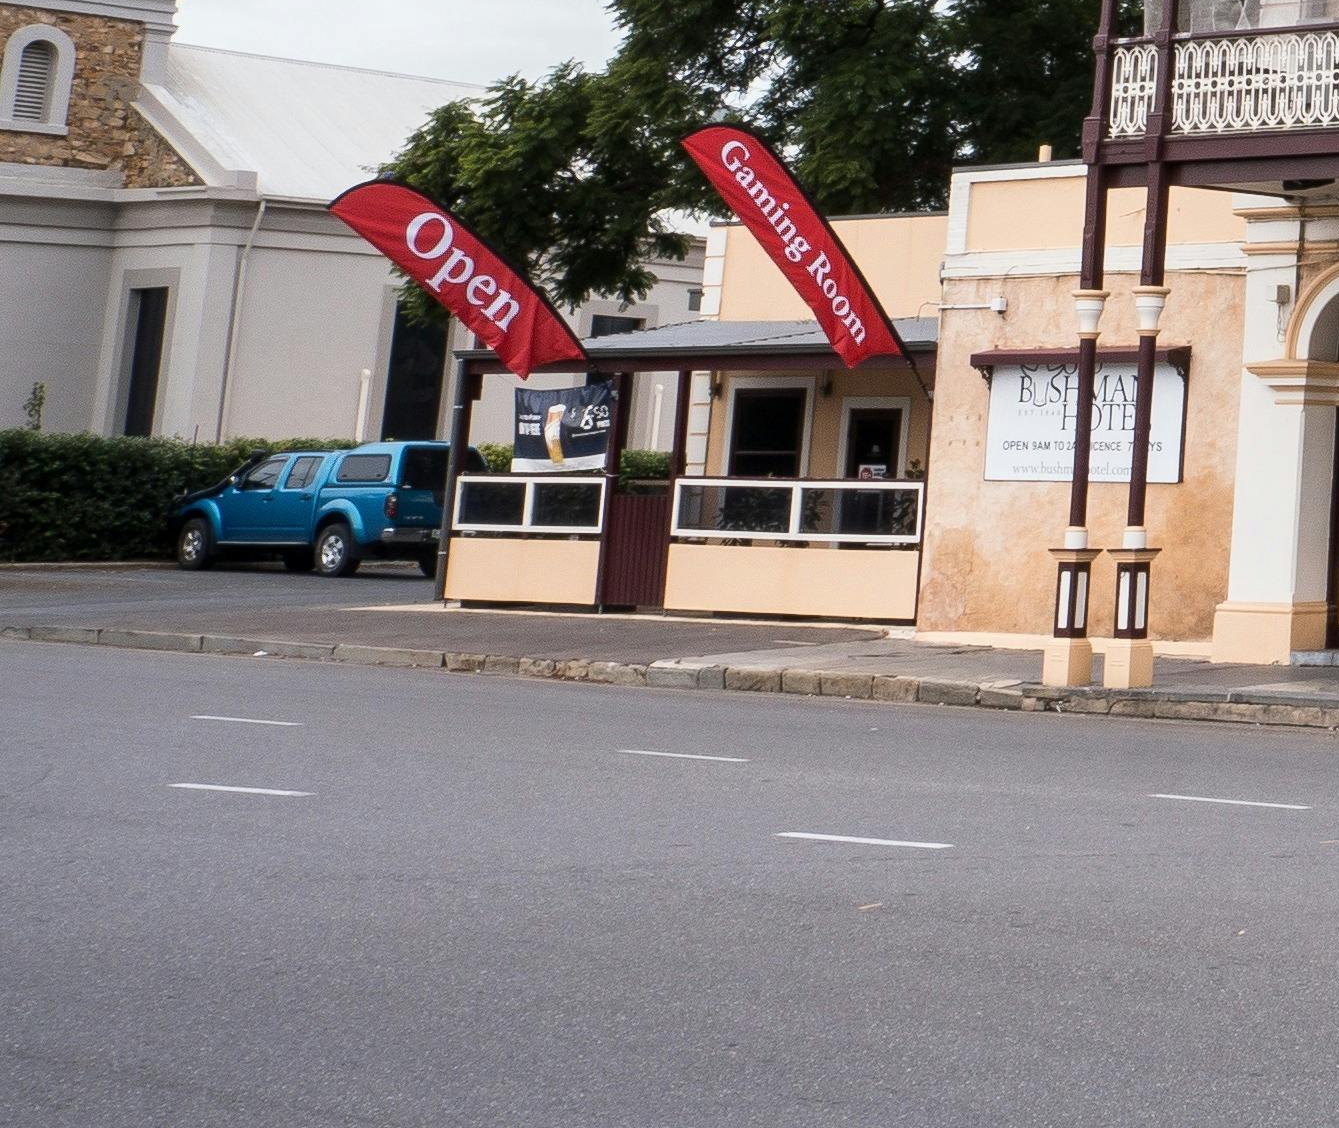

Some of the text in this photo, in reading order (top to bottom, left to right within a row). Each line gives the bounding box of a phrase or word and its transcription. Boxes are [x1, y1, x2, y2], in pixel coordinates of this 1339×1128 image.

[405, 210, 521, 332] Open
[720, 139, 867, 345] Gaming Room
[1002, 440, 1029, 451] OPEN
[1031, 441, 1051, 451] 9AM
[1054, 441, 1065, 451] TO
[1090, 441, 1121, 452] ICENCE
[1061, 403, 1151, 431] HOTE
